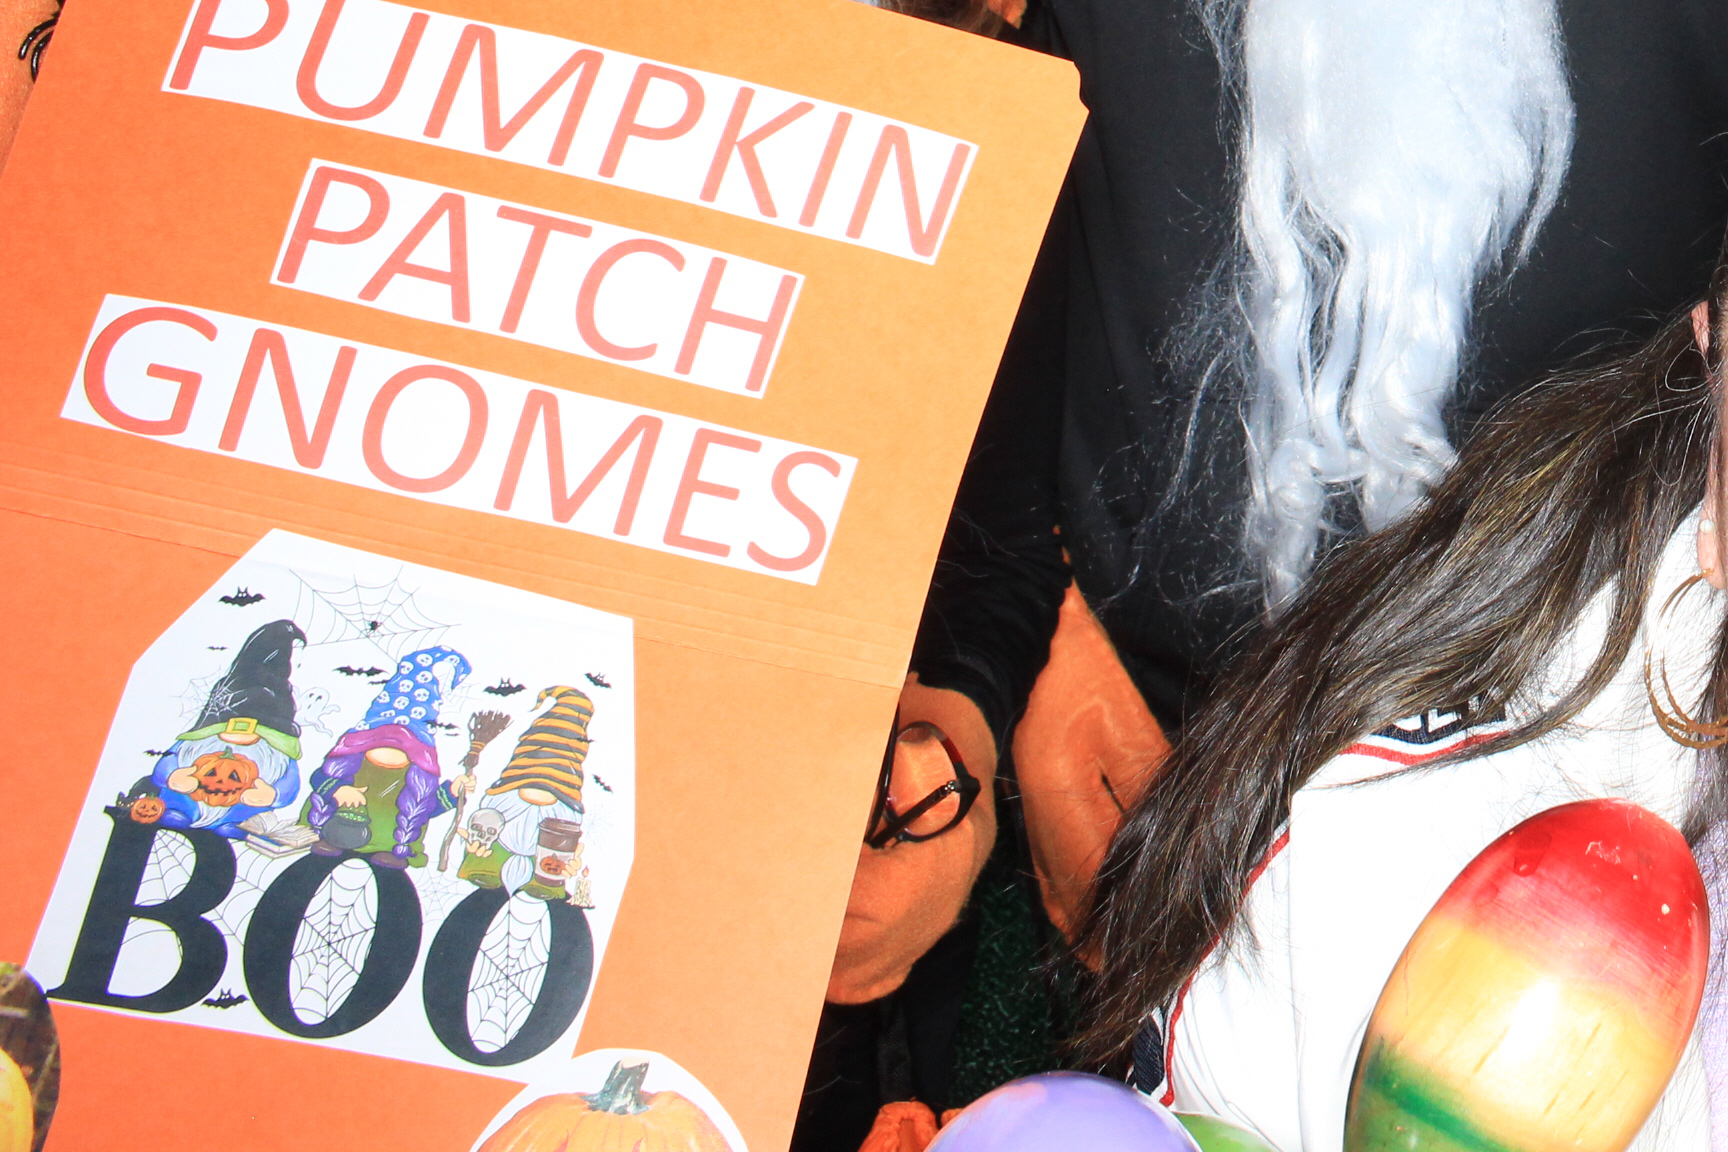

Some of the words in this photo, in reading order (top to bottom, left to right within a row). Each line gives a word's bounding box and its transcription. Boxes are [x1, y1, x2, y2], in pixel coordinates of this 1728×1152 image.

[277, 165, 798, 388] PATCH
[82, 306, 843, 572] GNOMES
[46, 805, 595, 1068] BOO
